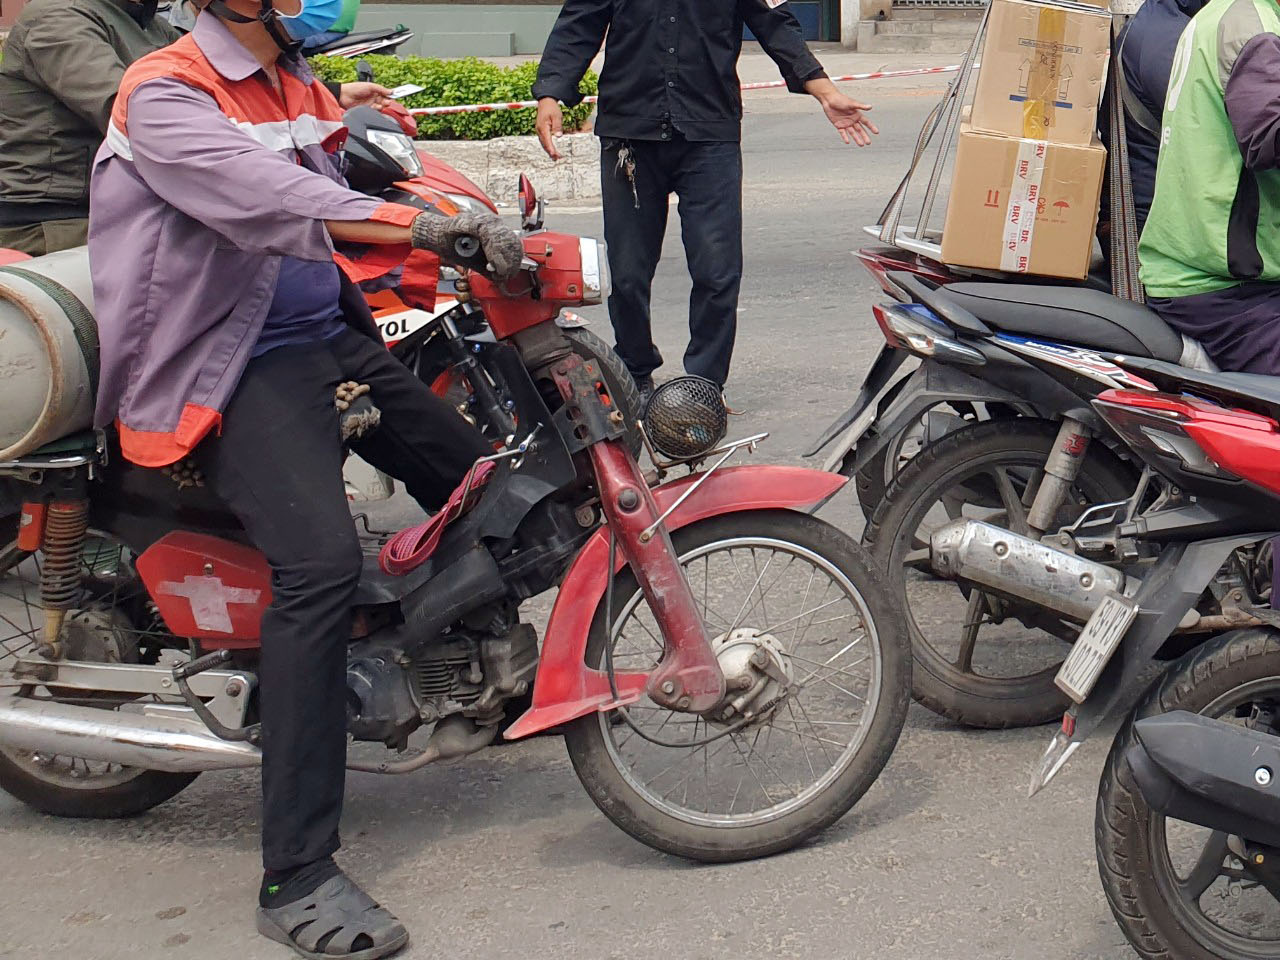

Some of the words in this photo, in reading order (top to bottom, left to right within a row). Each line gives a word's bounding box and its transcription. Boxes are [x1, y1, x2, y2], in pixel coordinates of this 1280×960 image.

[1019, 160, 1029, 179] BRV
[1028, 184, 1038, 204] BRV
[1011, 205, 1021, 225] BRV
[379, 318, 410, 337] OL
